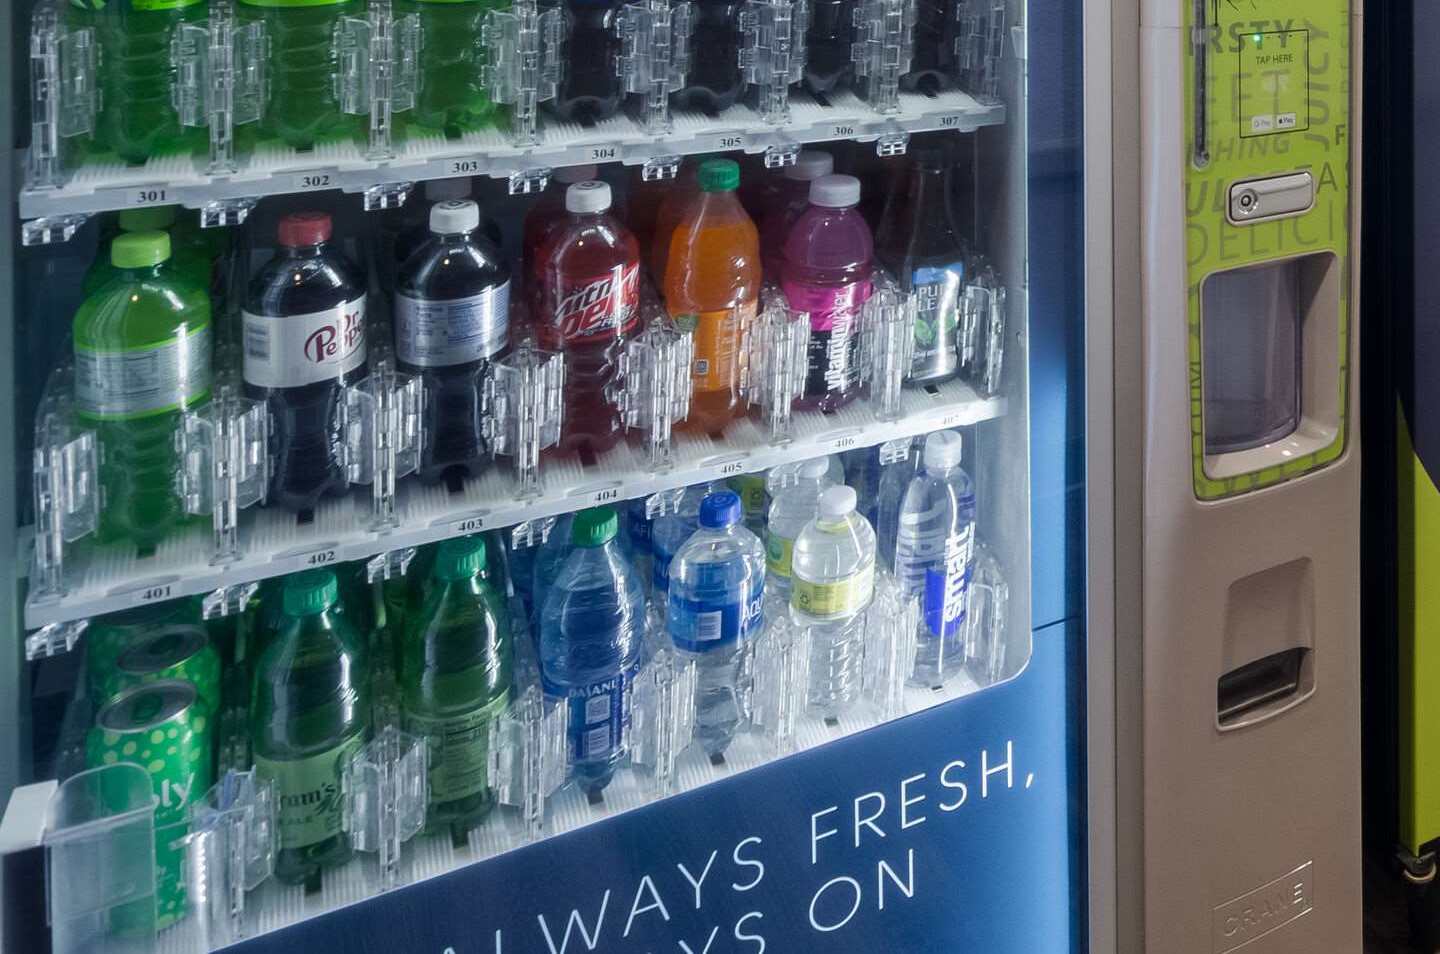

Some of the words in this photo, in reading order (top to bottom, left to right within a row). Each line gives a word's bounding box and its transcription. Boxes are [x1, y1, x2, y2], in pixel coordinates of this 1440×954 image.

[1256, 56, 1271, 65] TAP
[1272, 54, 1294, 64] HERE
[938, 115, 959, 127] 307
[833, 124, 854, 136] 306
[719, 136, 742, 149] 305
[591, 148, 616, 161] 304
[452, 160, 479, 174] 303
[302, 174, 330, 189] 302
[136, 189, 167, 204] 301
[940, 414, 960, 426] 407
[834, 436, 856, 448] 406
[720, 461, 743, 474] 405
[594, 488, 618, 502] 404
[457, 518, 484, 532] 403
[307, 550, 336, 566] 402
[142, 584, 173, 600] 401
[810, 740, 1036, 864] FRESH,
[809, 849, 916, 932] ON
